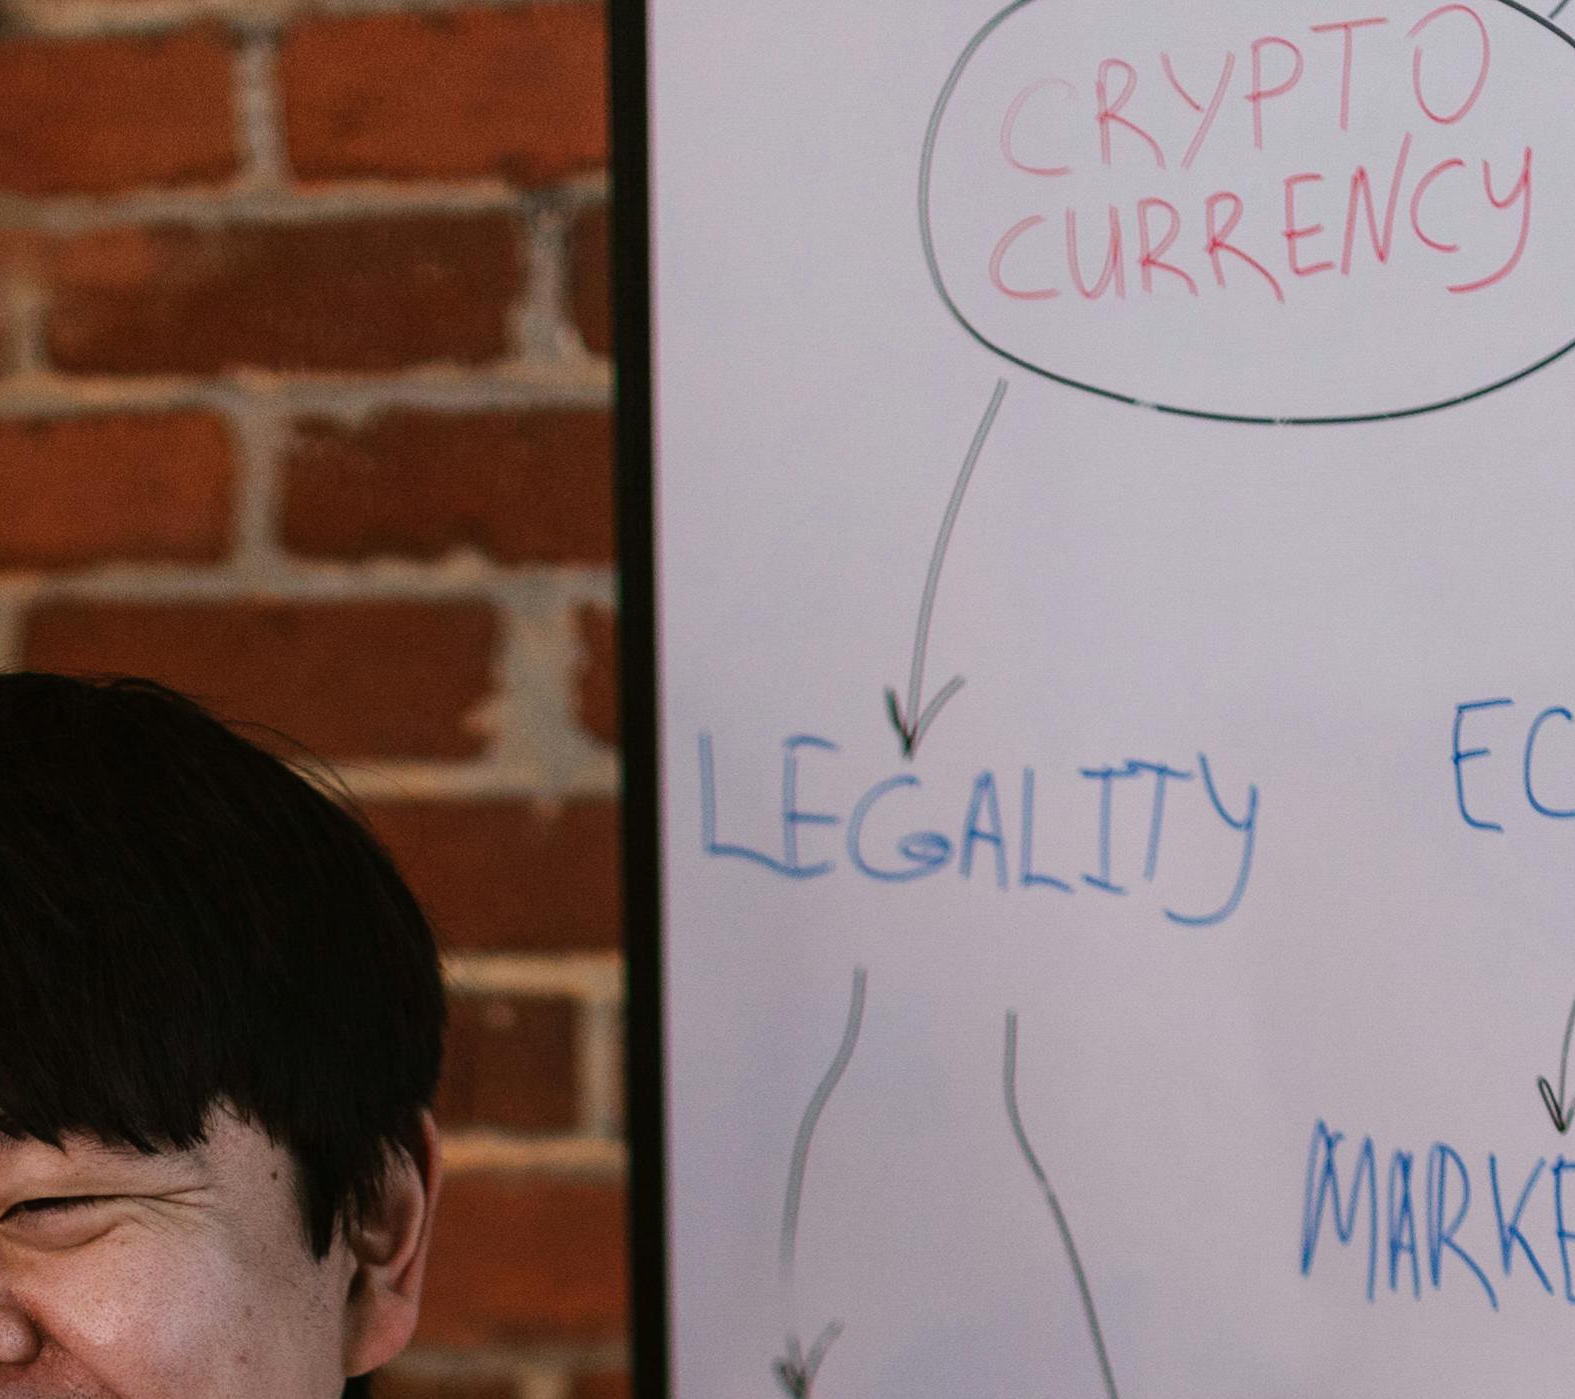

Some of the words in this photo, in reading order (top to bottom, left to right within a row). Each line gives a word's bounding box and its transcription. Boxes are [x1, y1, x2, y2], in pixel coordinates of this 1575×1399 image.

[998, 3, 1493, 177] CRYPTO
[989, 132, 1534, 303] CURRENCY
[699, 732, 1259, 924] LEGALITY
